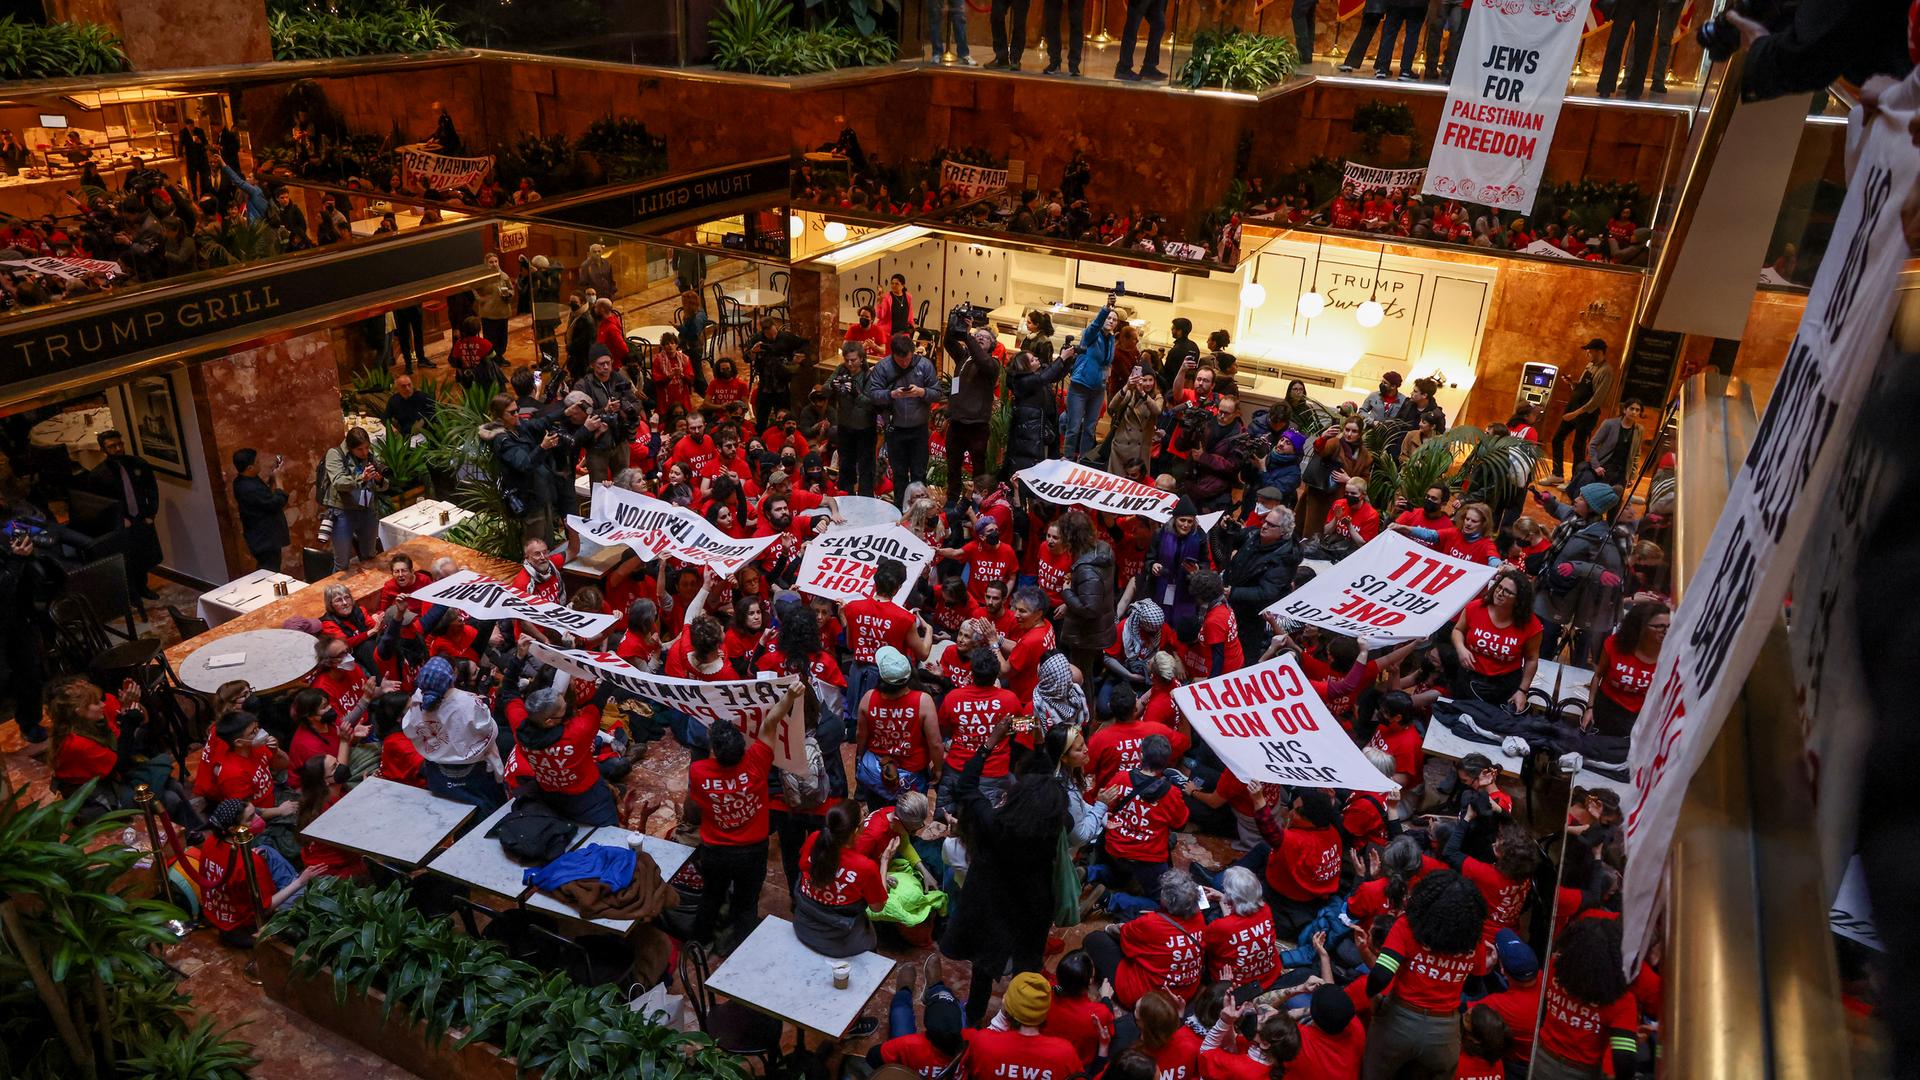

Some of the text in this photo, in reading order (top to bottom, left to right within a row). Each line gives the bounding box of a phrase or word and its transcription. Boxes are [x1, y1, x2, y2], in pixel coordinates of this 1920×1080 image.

[1482, 45, 1539, 74] JEWS
[1483, 75, 1524, 102] FOR
[1451, 100, 1544, 131] PALESTINIAN
[1442, 122, 1537, 160] FREEDOM
[404, 152, 432, 170] FREE
[944, 165, 1008, 188] FREE MAH
[1331, 273, 1405, 294] TRUMP
[14, 285, 280, 368] TRUMP GRILL
[690, 455, 706, 463] NOT
[1027, 478, 1101, 501] DEPORT
[1062, 467, 1170, 500] MOVEMENT
[1099, 493, 1161, 511] CAN'T
[590, 521, 615, 537] IS
[615, 502, 755, 557] JEWISH TRADITION
[820, 535, 924, 562] STUDENTS
[817, 557, 878, 580] AZIS
[977, 560, 1006, 569] NOT IN
[978, 567, 1001, 577] OUR
[1387, 550, 1467, 596] ALL
[432, 581, 506, 609] AGAIN
[1350, 574, 1440, 615] FACE US
[544, 606, 597, 629] FOR
[1285, 600, 1333, 622] FOR
[1329, 588, 1407, 627] ONE,
[1690, 515, 1756, 701] BAN
[857, 614, 892, 630] JEWS
[859, 626, 886, 639] SAY
[1474, 628, 1518, 646] NOT IN
[1476, 639, 1511, 655] OUR
[949, 664, 966, 675] NOT
[1188, 664, 1304, 711] COMPLY
[870, 707, 914, 719] JEWS
[953, 699, 1001, 714] JEWS
[875, 719, 908, 731] SAY
[958, 712, 995, 725] SAY
[1210, 702, 1320, 738] DO NOT
[1117, 738, 1143, 751] JEW
[1259, 740, 1312, 764] SAY
[528, 755, 568, 769] SAY
[1118, 761, 1141, 772] STO
[1121, 751, 1143, 762] SA
[701, 773, 749, 790] JEWS
[1265, 764, 1343, 783] JEWS
[1122, 801, 1150, 817] AY
[1166, 930, 1203, 948] JEWS
[1229, 920, 1272, 945] JEWS
[1237, 934, 1271, 956] SAY
[1236, 946, 1273, 966] STOP
[1414, 952, 1474, 972] ARMING
[995, 1063, 1053, 1080] JEWS
[1159, 1065, 1186, 1080] WS
